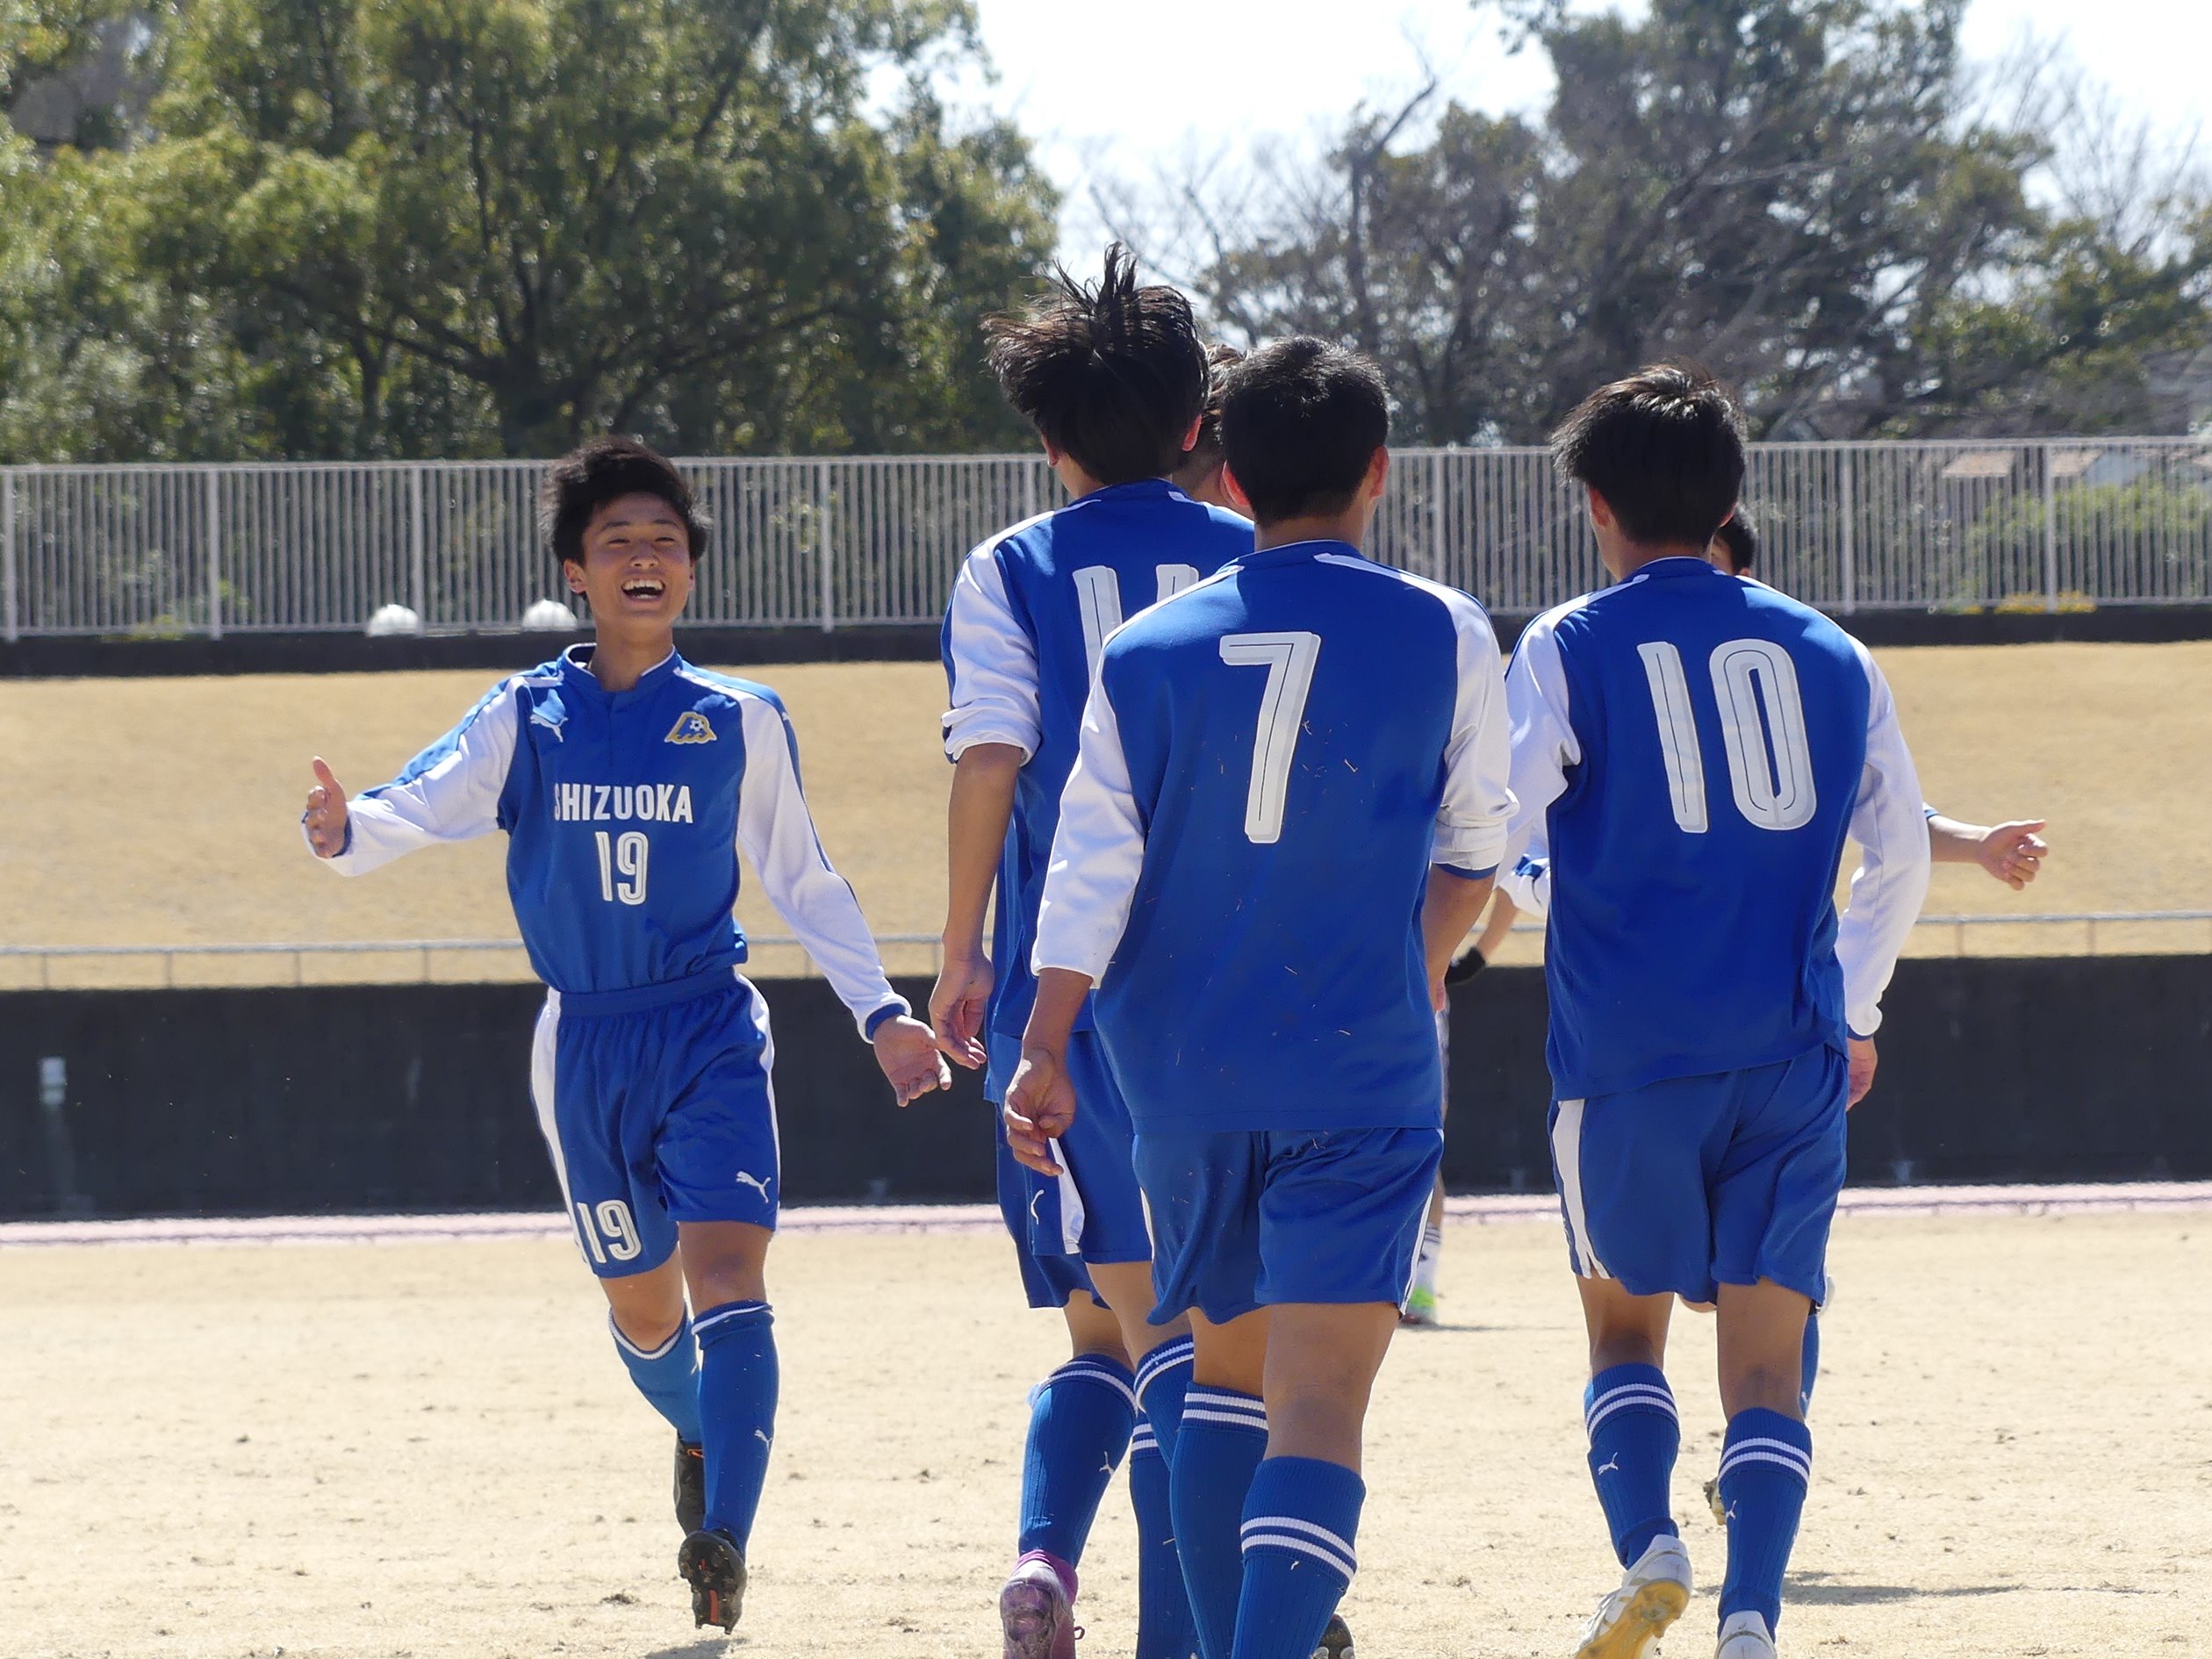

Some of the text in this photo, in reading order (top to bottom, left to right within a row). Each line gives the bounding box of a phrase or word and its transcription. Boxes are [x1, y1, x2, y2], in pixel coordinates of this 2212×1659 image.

[1073, 564, 1200, 691] 1
[1219, 631, 1321, 844] 7
[1637, 638, 1817, 833] 10
[595, 831, 649, 905] 19
[577, 1199, 642, 1263] 19
